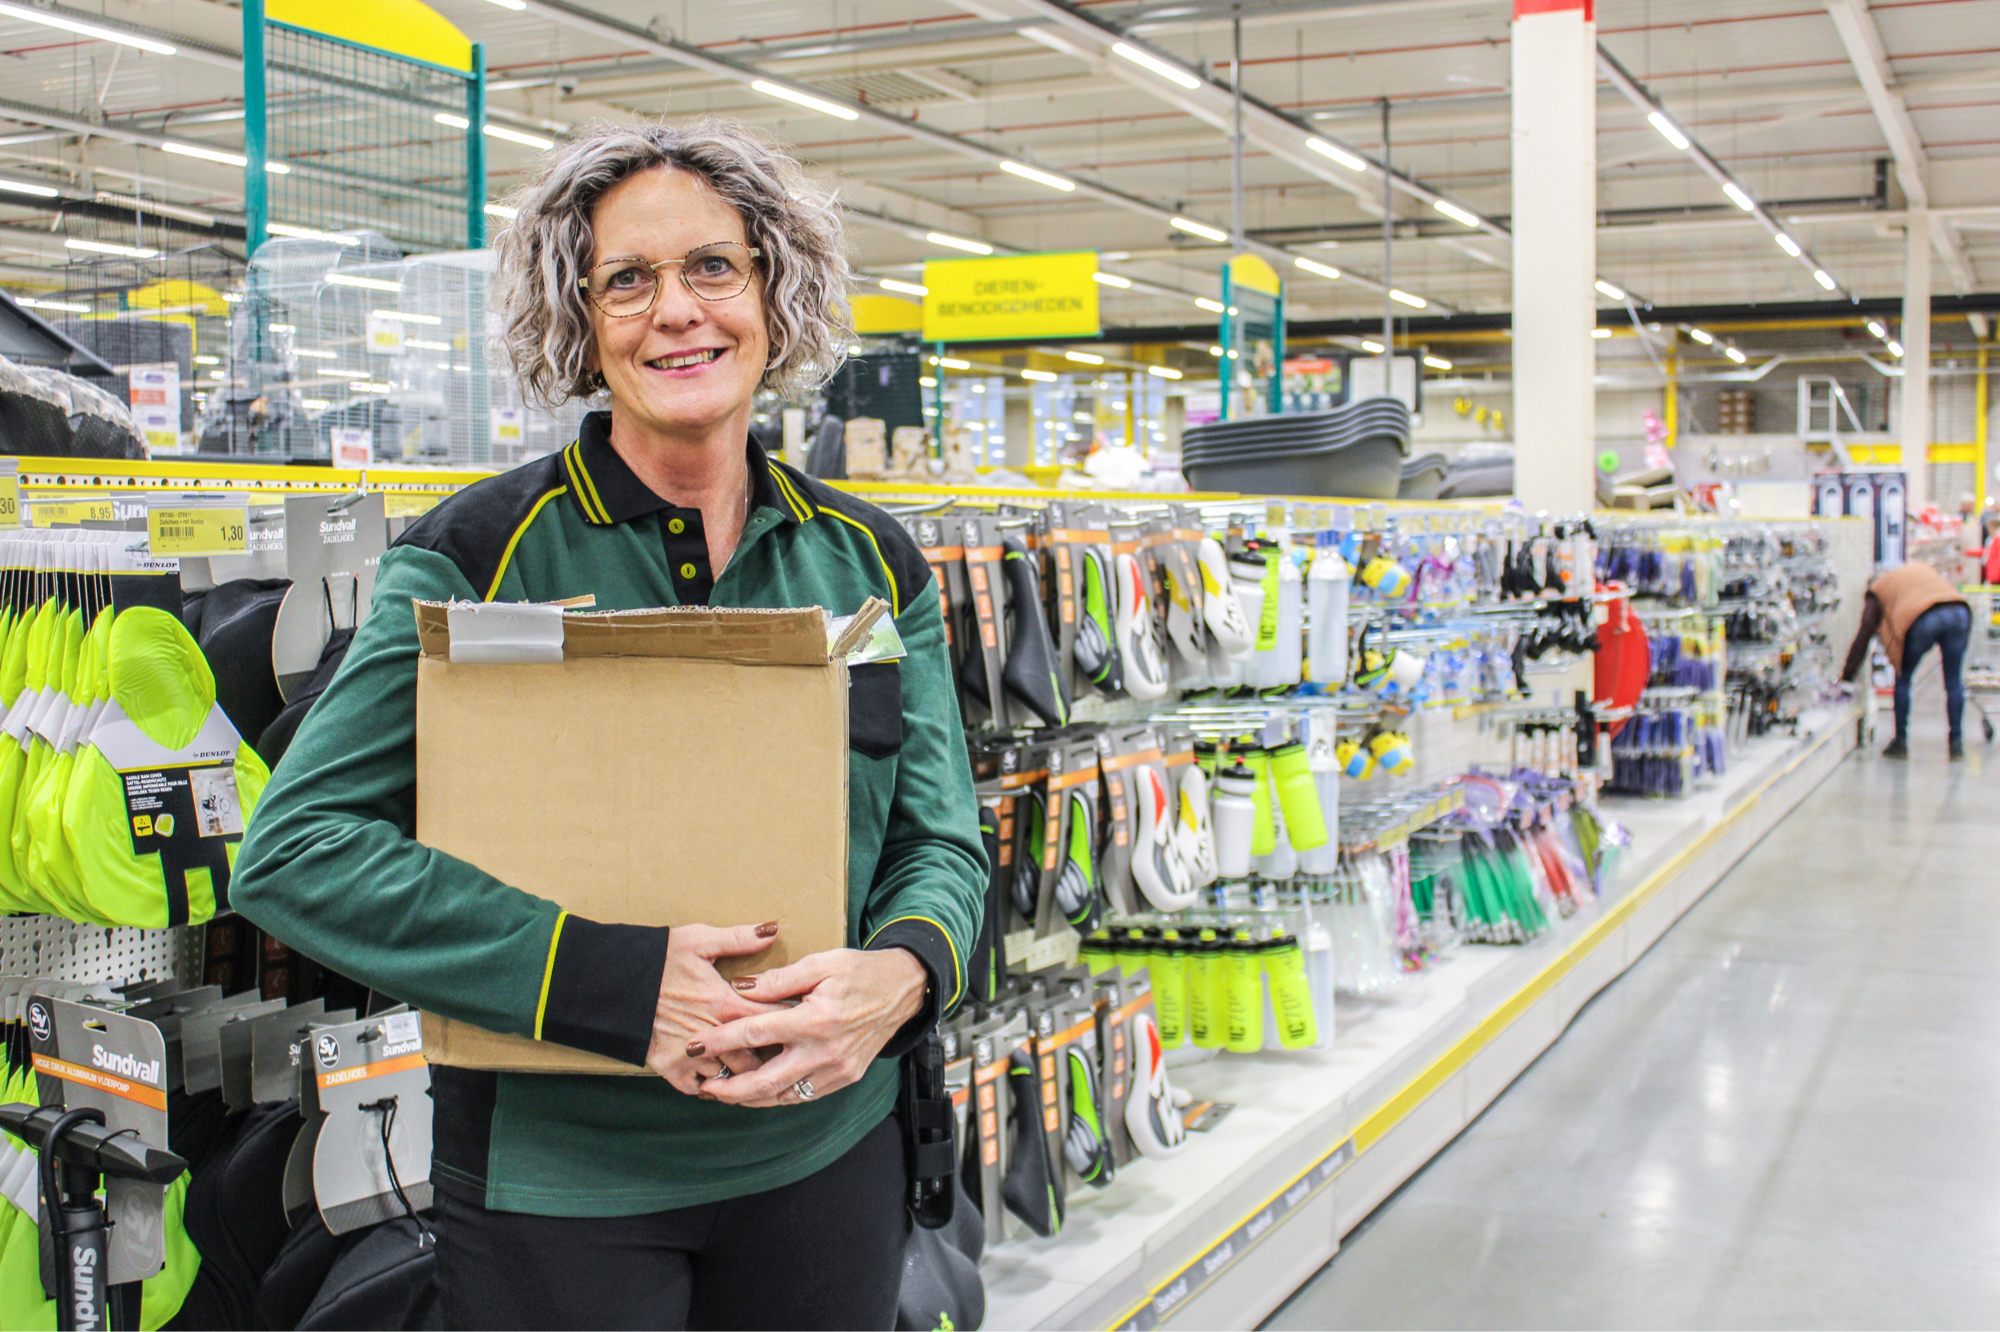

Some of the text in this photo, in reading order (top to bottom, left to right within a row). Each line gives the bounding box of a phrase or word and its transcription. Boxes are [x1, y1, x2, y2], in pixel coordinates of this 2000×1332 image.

[90, 507, 111, 520] 8,95
[221, 525, 244, 543] 1,30
[249, 528, 284, 540] undvall
[320, 519, 357, 533] Sundvall
[323, 533, 355, 544] ZADELHOES
[200, 750, 231, 758] DUNLOP
[382, 1038, 422, 1058] Sundvall
[92, 1044, 160, 1084] Sundvall
[35, 1058, 130, 1093] HOGE DRUK ALUMINIUM VLOERPOMP
[326, 1067, 367, 1085] ZADELHOES
